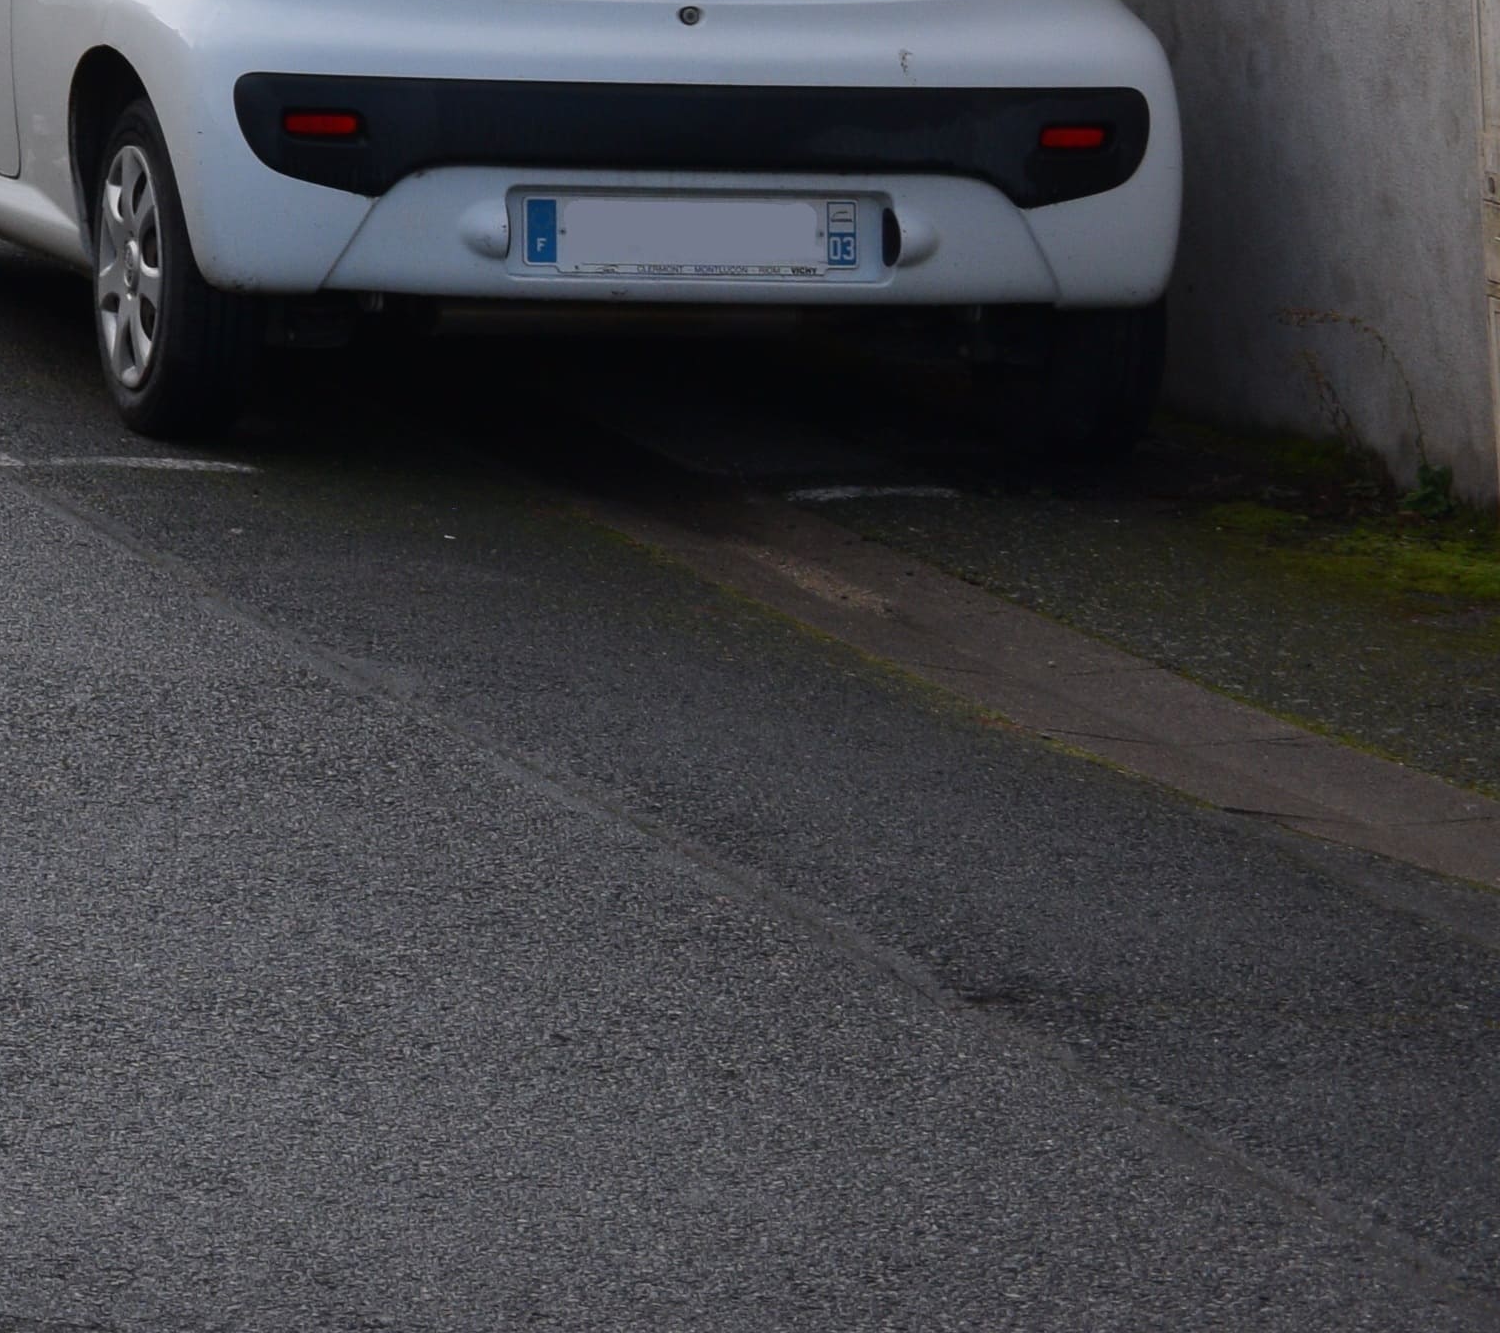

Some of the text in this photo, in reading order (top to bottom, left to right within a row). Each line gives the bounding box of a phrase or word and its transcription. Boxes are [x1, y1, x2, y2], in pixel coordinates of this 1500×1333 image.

[536, 237, 547, 252] F
[829, 236, 855, 261] 03
[791, 266, 818, 275] VICHY
